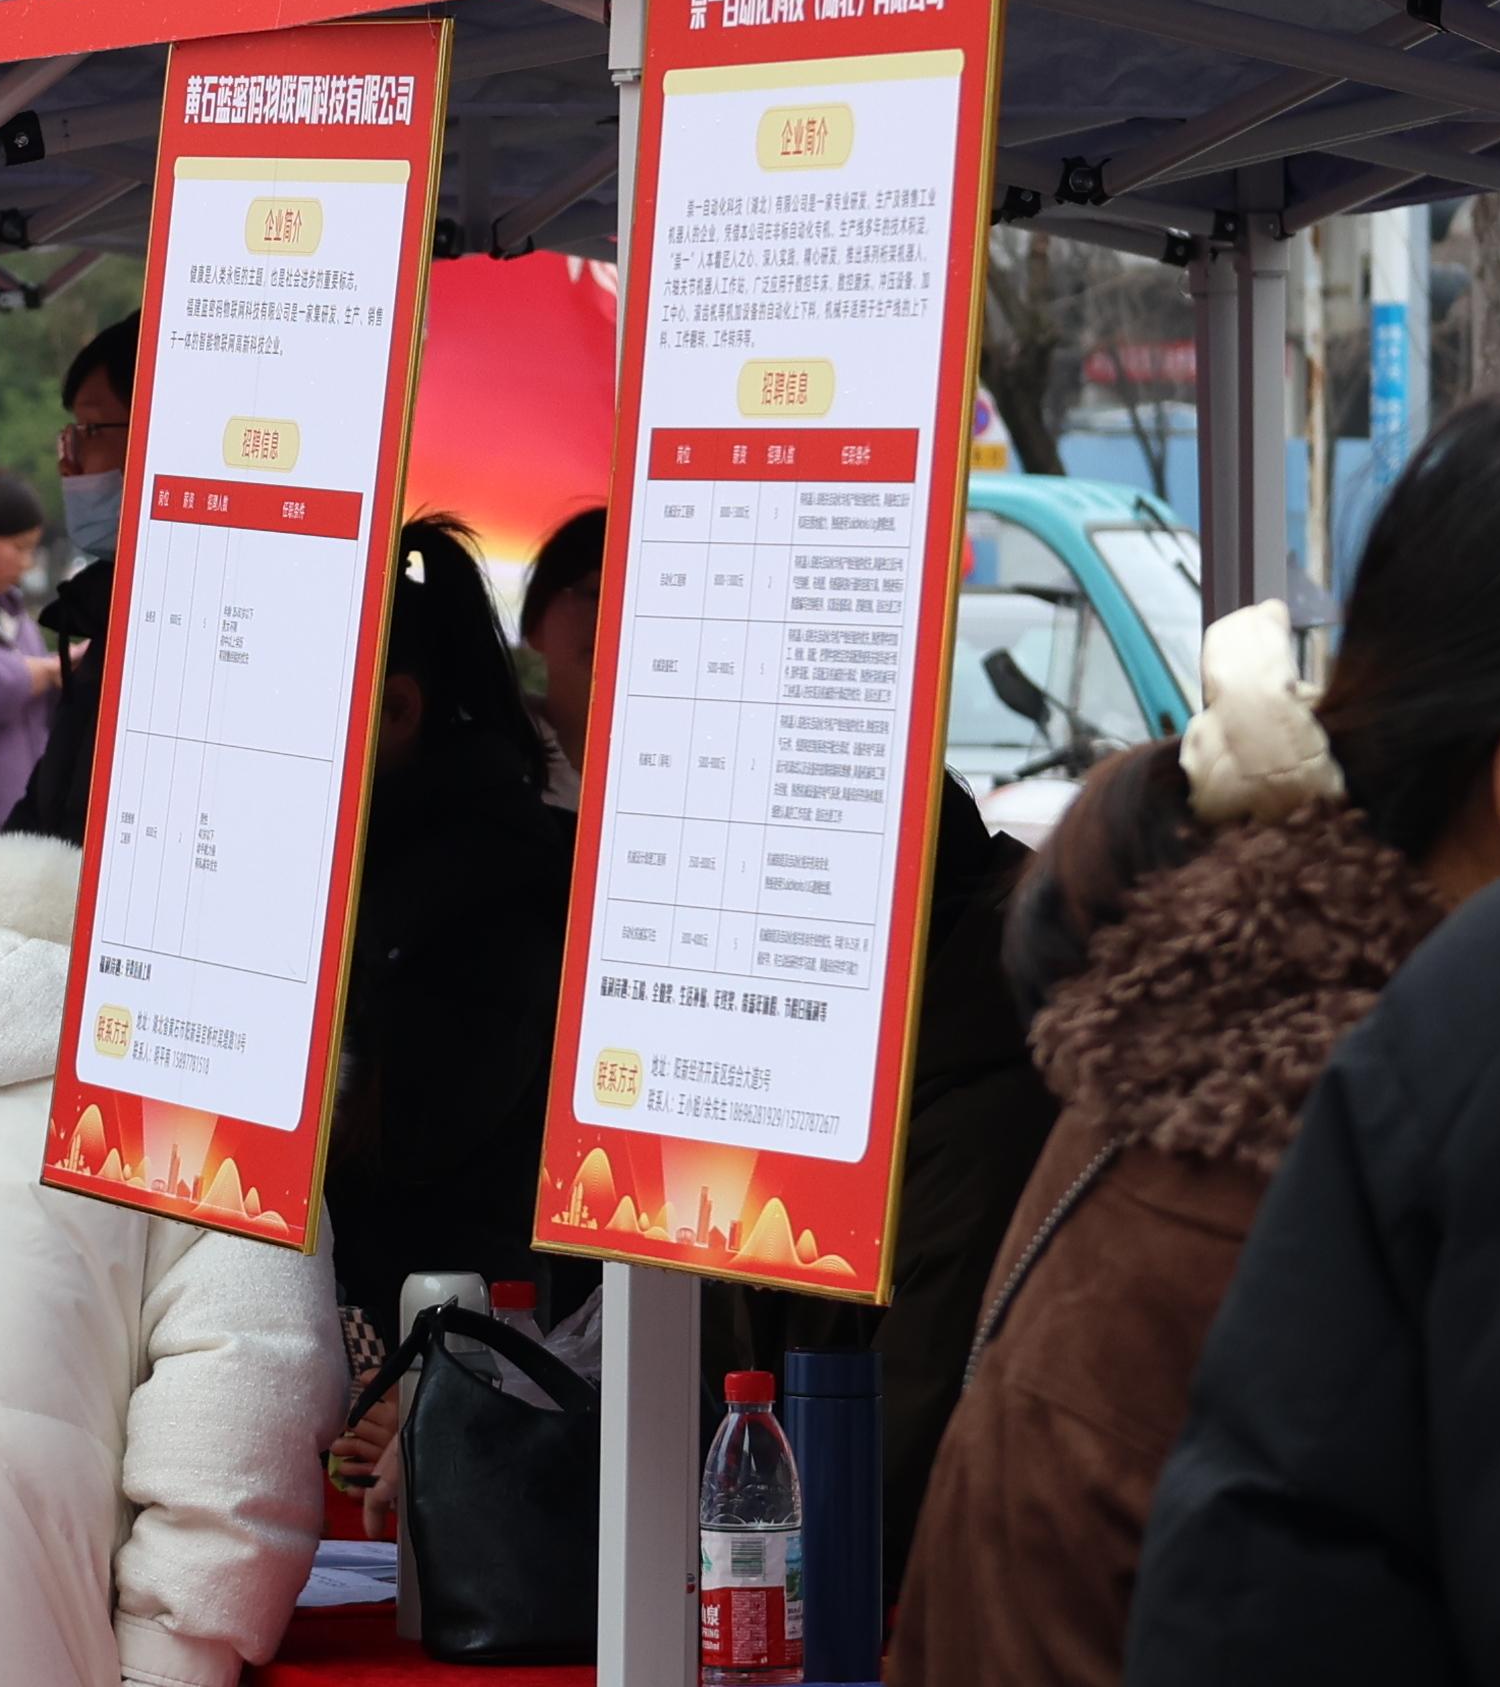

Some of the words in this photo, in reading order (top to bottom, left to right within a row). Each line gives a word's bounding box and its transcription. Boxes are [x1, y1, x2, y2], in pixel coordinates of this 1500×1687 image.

[184, 75, 416, 126] 黄石蓝密码物联网科技有限公司
[780, 117, 830, 157] 企业简介
[263, 208, 303, 244] 企业简介
[96, 1015, 130, 1048] 联系方式
[596, 1061, 639, 1095] 联系方式
